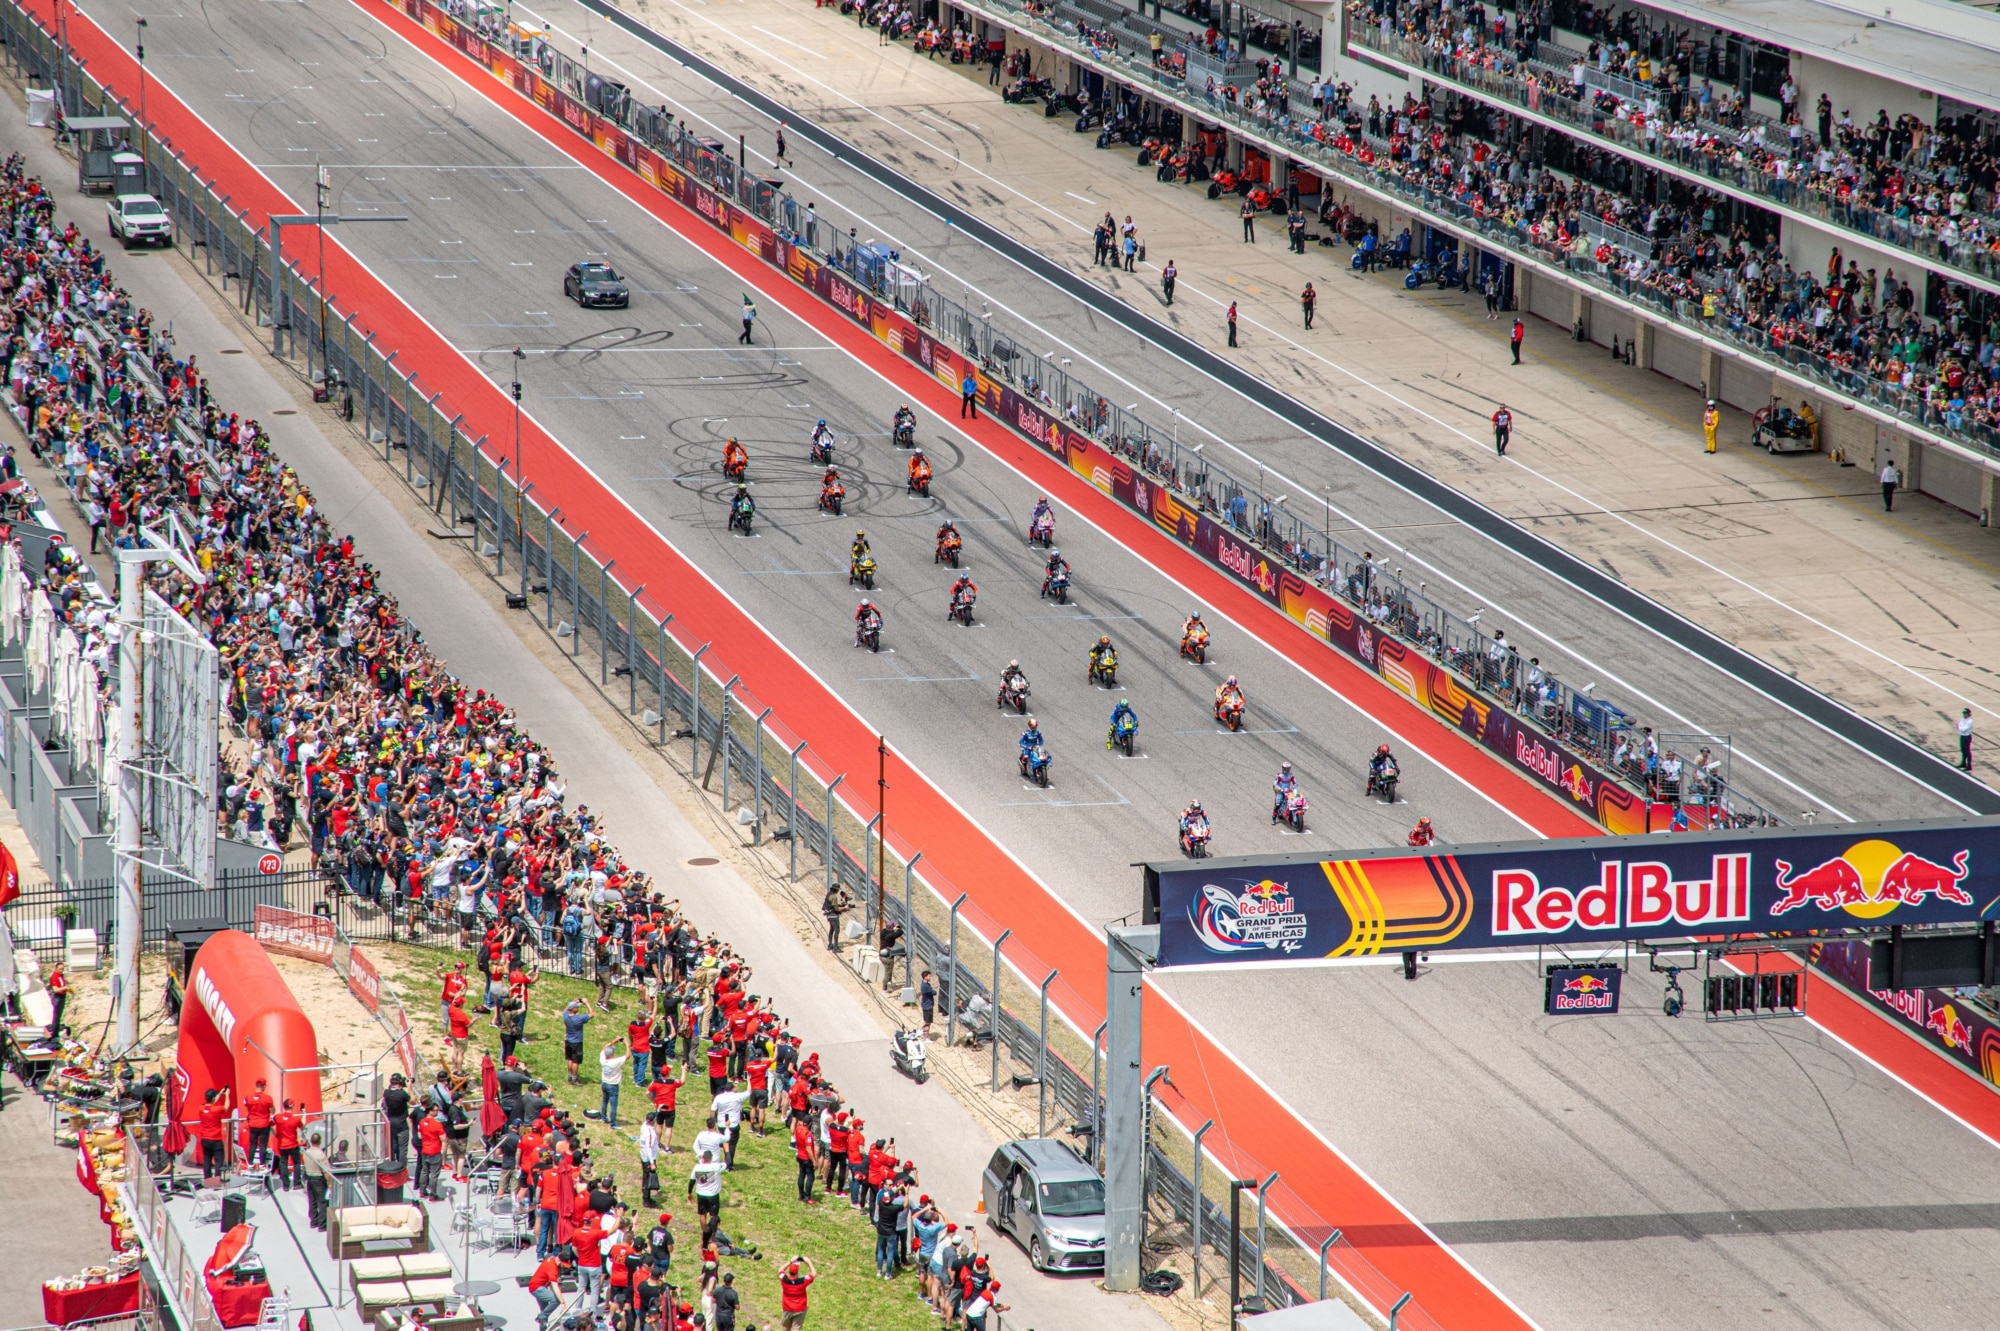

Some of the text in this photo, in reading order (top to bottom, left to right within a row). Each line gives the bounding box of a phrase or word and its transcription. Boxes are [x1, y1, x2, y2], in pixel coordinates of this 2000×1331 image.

[1517, 730, 1559, 785] Red Bull
[262, 859, 277, 870] 123
[1493, 854, 1751, 935] Red Bull
[1236, 915, 1304, 928] GRAND PRIX
[1247, 928, 1304, 940] AMERICAS
[257, 922, 334, 955] DUCATI
[350, 959, 379, 998] DUCATI
